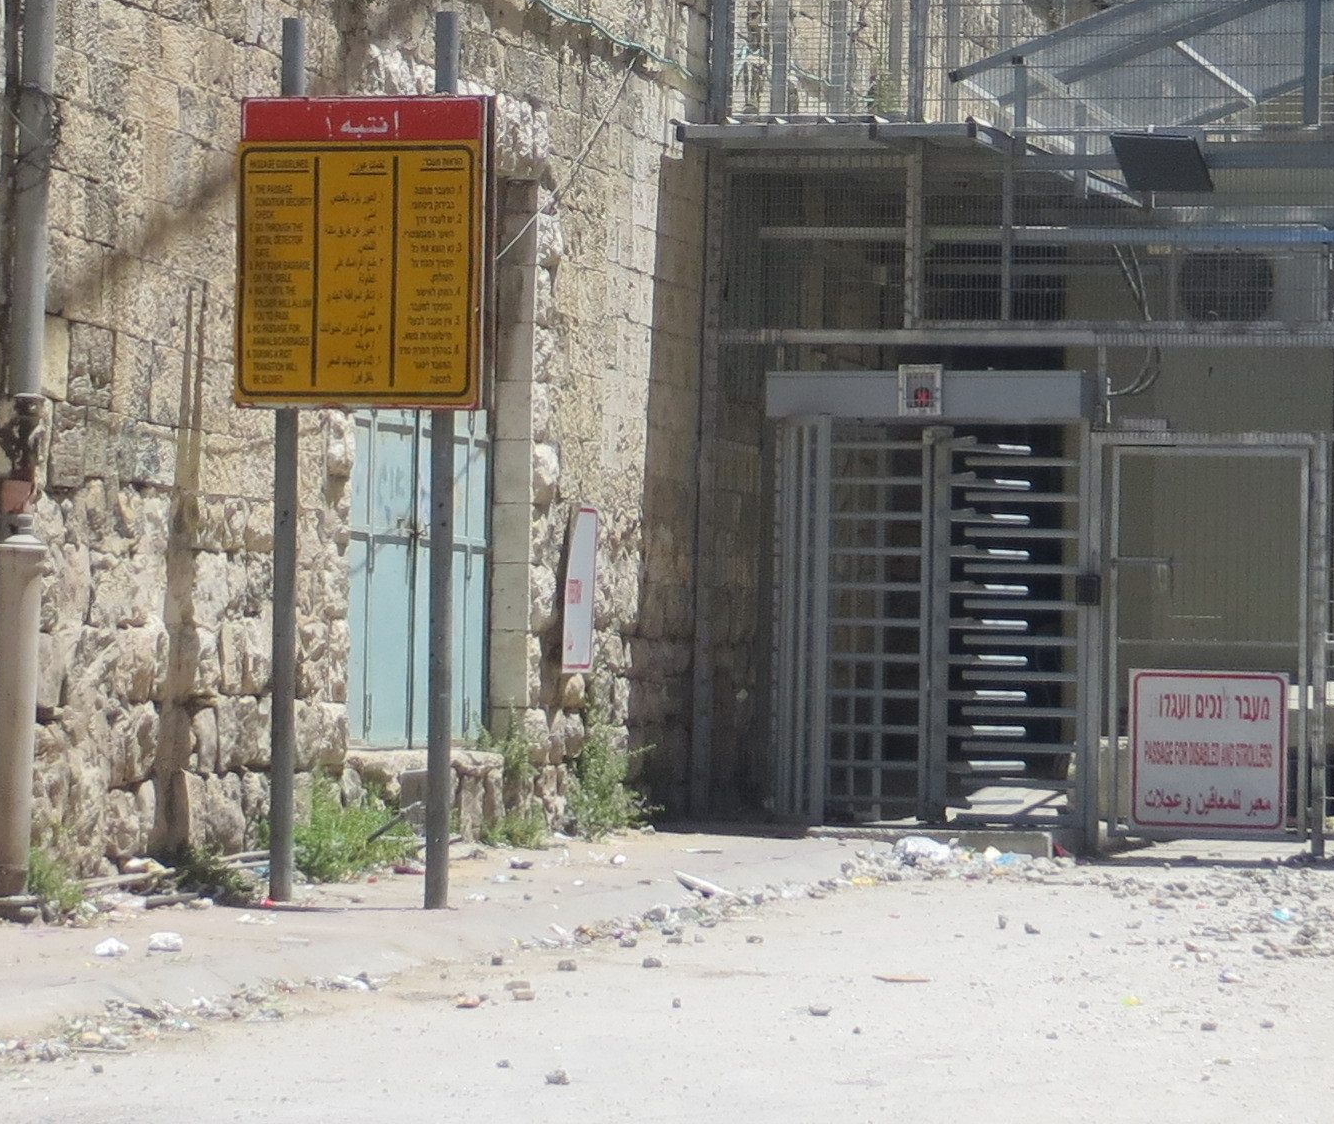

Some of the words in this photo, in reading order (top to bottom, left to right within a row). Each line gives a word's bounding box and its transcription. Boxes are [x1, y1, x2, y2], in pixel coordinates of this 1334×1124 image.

[267, 184, 293, 194] PASSAGE
[286, 197, 312, 207] SECURITY
[291, 222, 304, 232] THE
[273, 235, 303, 245] DETECTOR
[262, 323, 288, 333] PASSAGE
[288, 323, 301, 334] FOR
[1235, 695, 1270, 722] מעבר
[1144, 741, 1173, 765] PASSAGE
[1175, 741, 1187, 765] FOR
[1189, 741, 1219, 766] DISABLED
[1222, 743, 1234, 767] AND
[1236, 743, 1272, 768] STROLLERS
